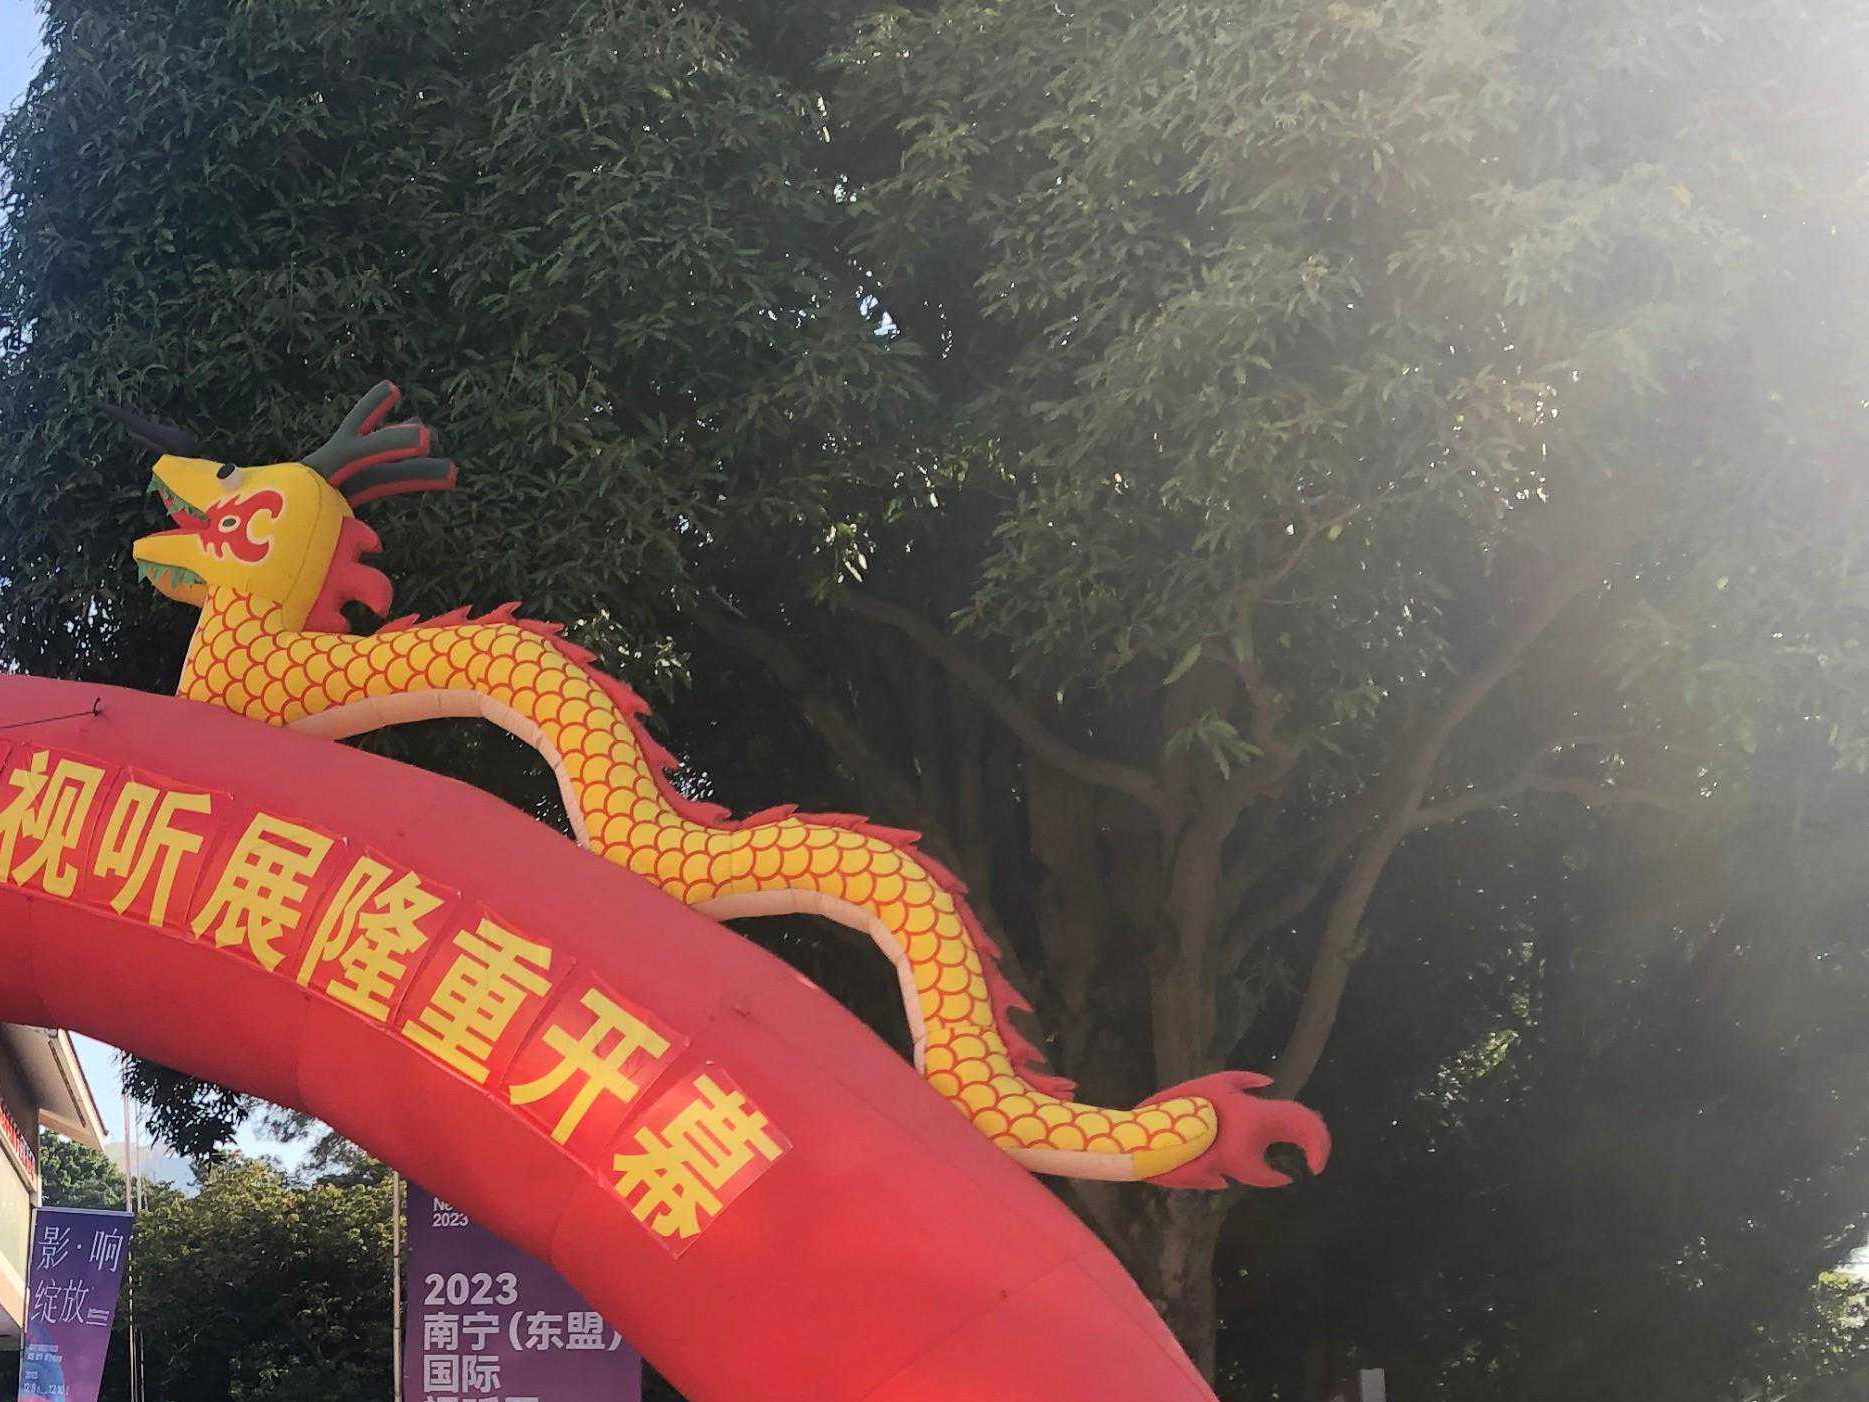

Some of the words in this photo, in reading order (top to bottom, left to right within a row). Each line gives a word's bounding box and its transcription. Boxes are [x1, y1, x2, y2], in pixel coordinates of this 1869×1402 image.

[31, 1279, 89, 1324] 绽放
[423, 1272, 518, 1306] 2023
[422, 1354, 501, 1393] 国际
